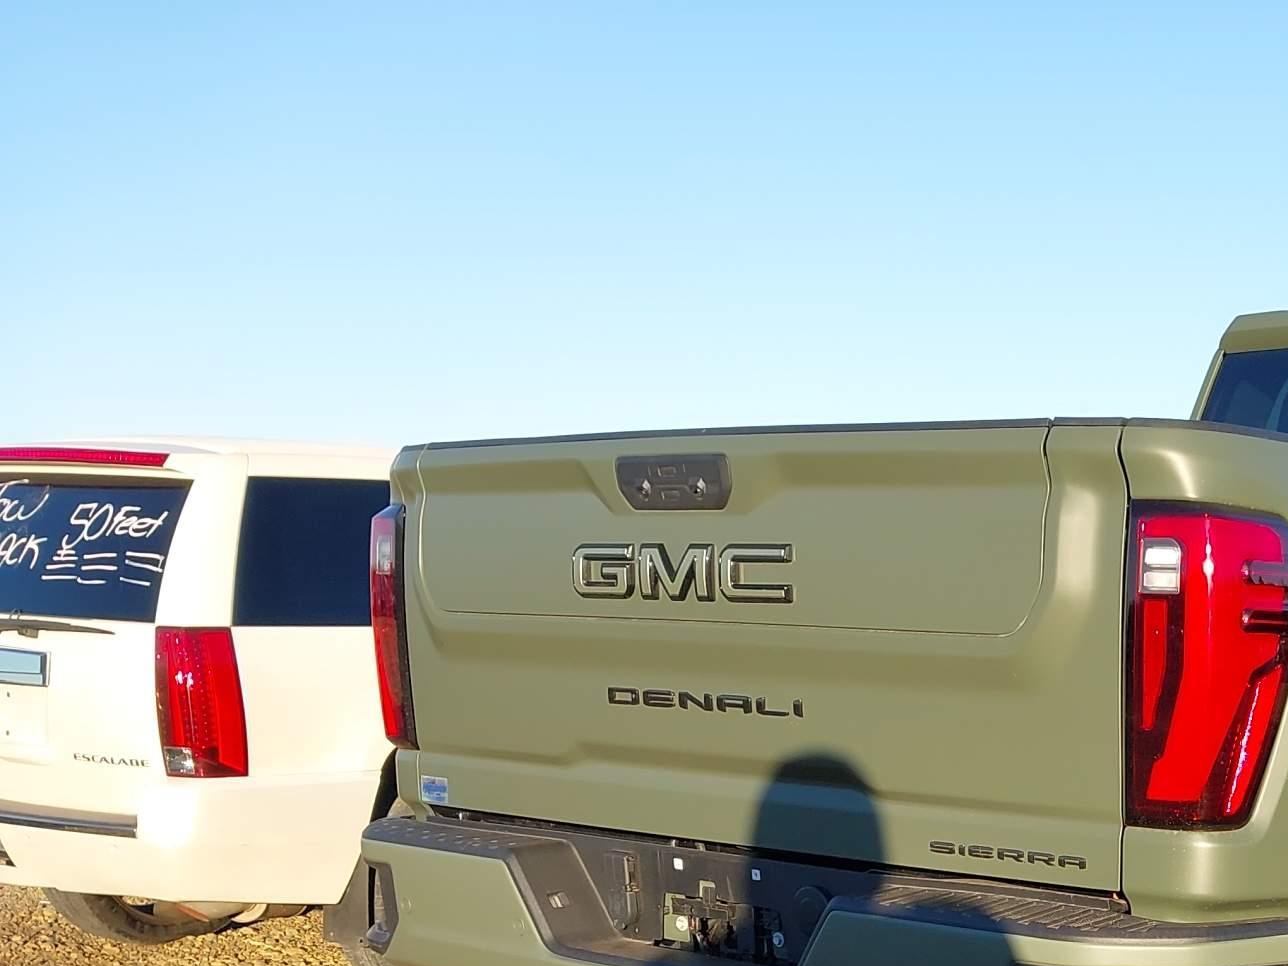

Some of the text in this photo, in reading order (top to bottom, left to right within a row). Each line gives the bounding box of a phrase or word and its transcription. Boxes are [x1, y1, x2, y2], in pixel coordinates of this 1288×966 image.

[572, 543, 794, 603] GMC
[607, 687, 804, 718] DENALI
[73, 752, 151, 768] ESCALADE
[929, 840, 1088, 870] SIERRA
